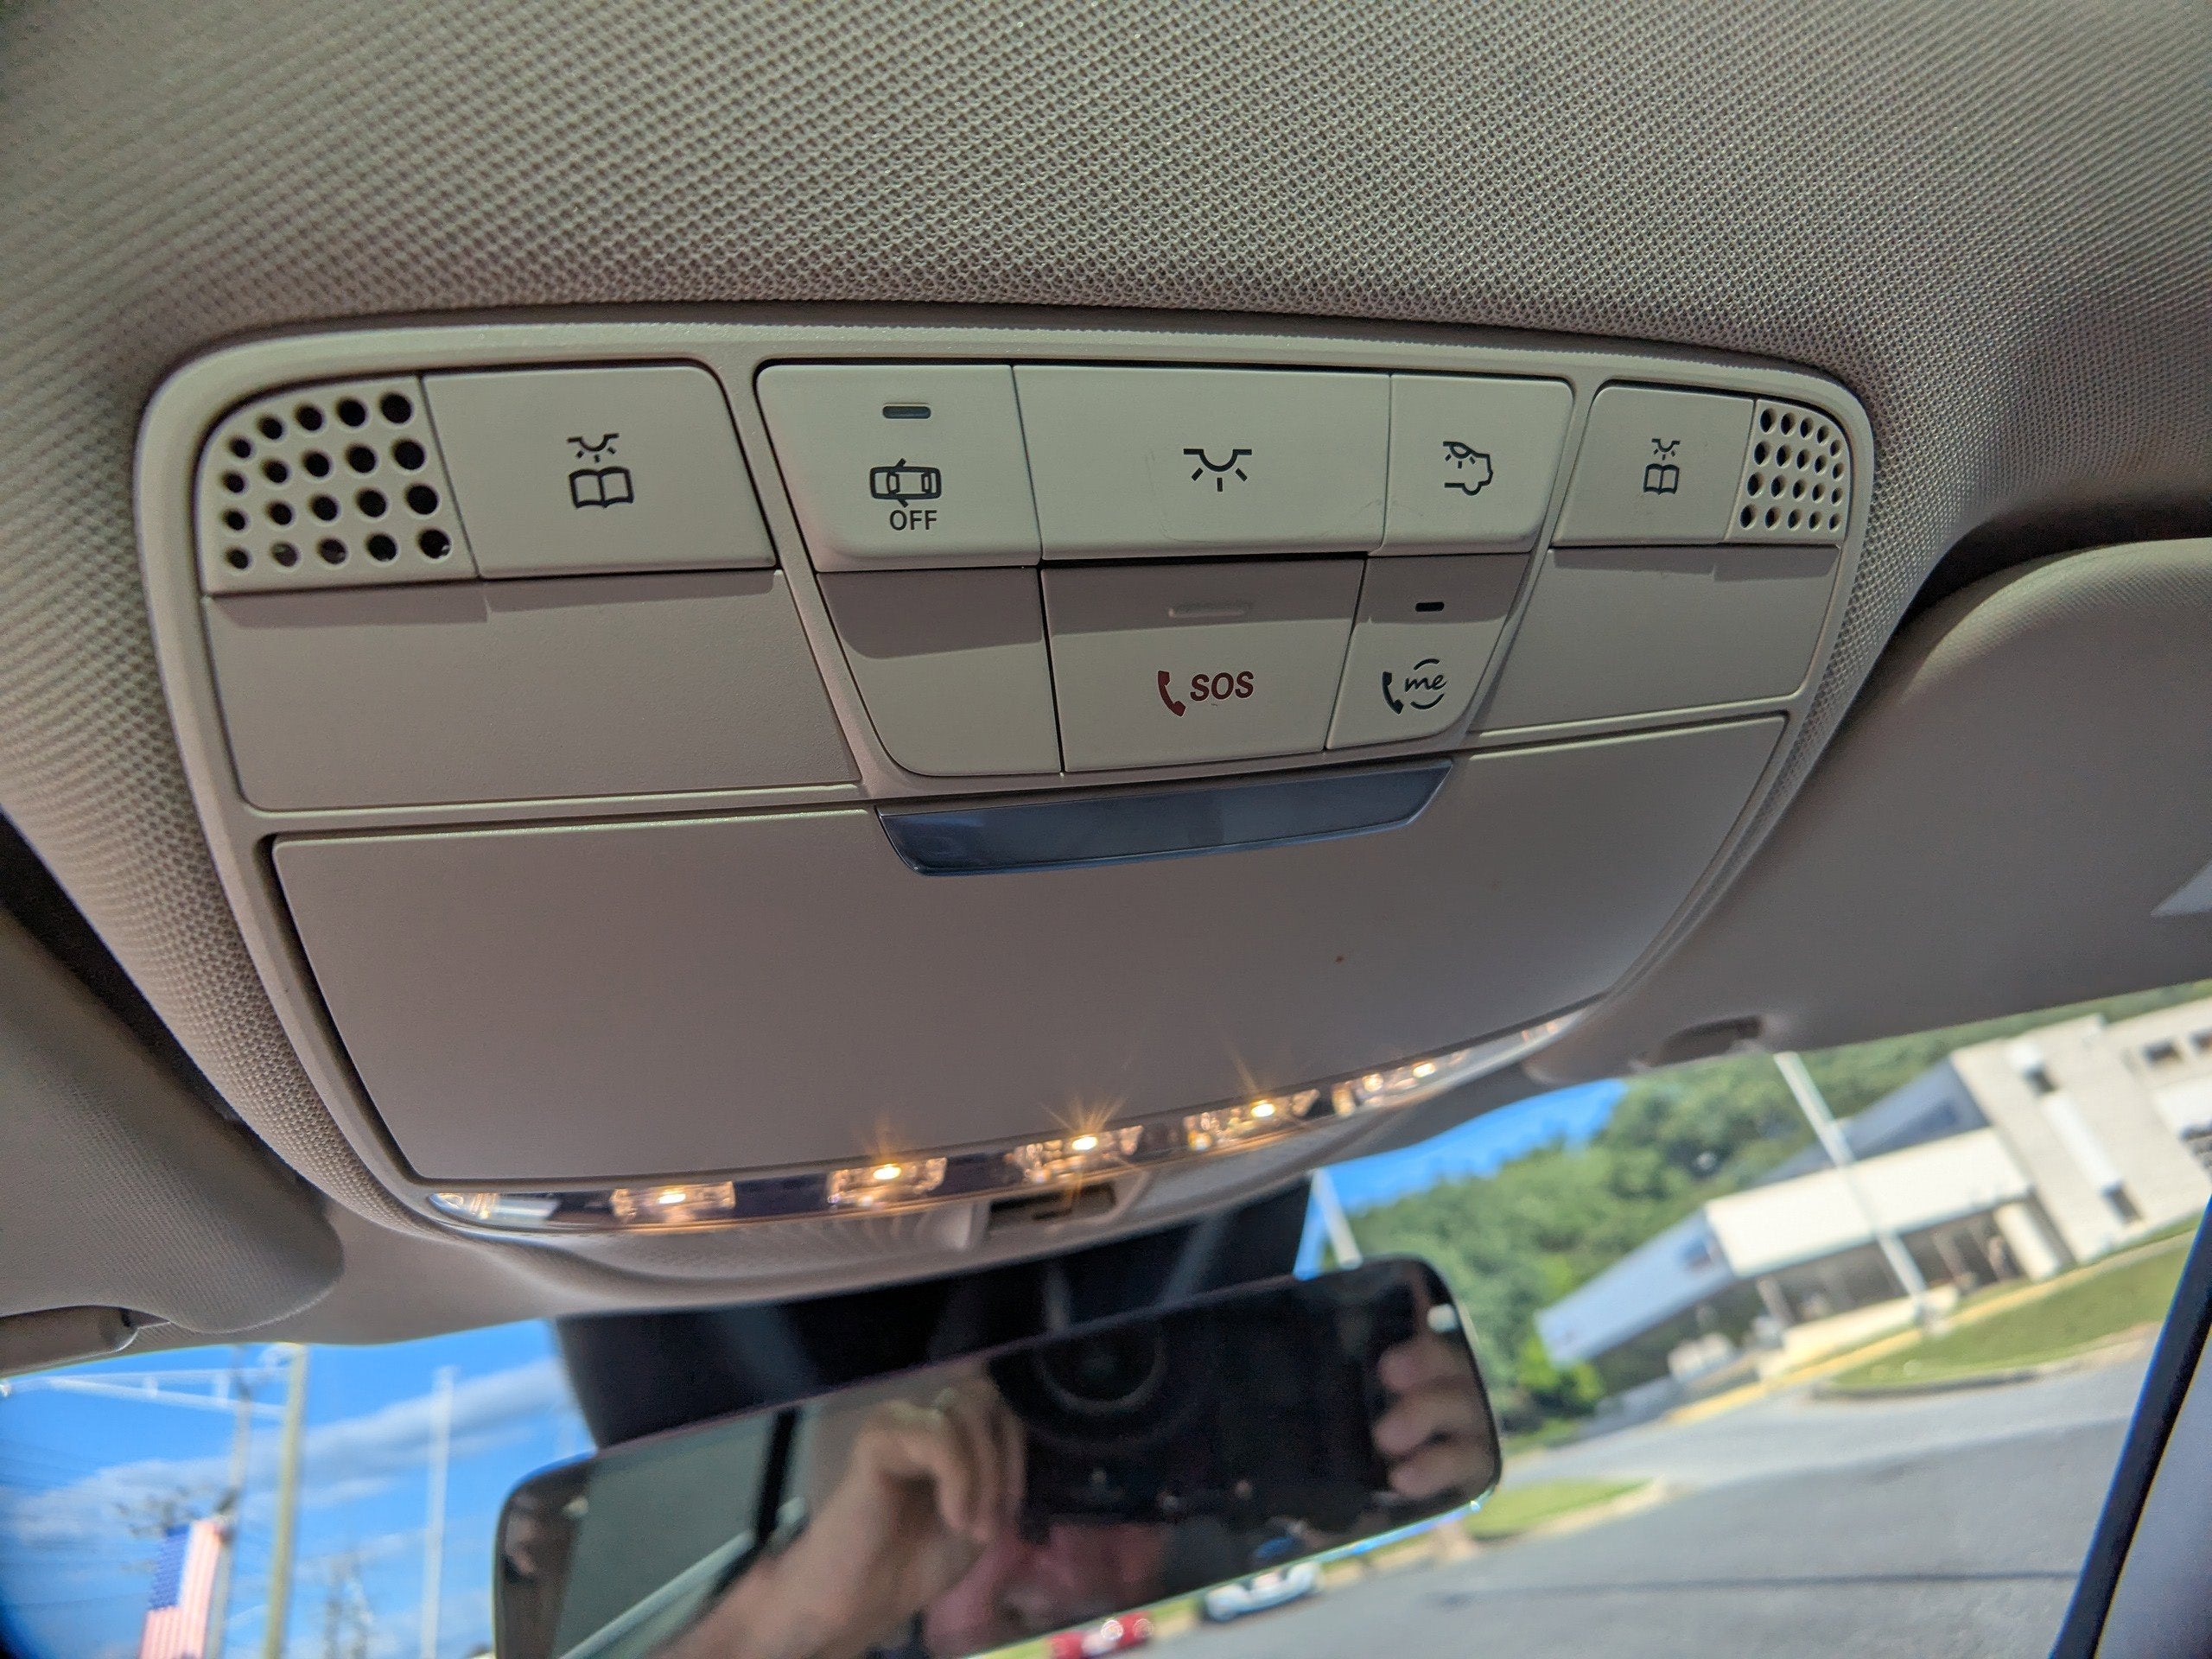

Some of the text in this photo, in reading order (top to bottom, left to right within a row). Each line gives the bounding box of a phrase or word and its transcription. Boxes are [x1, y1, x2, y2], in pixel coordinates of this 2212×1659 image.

[889, 509, 937, 531] OFF
[1190, 671, 1254, 702] SOS
[1404, 674, 1447, 692] me
